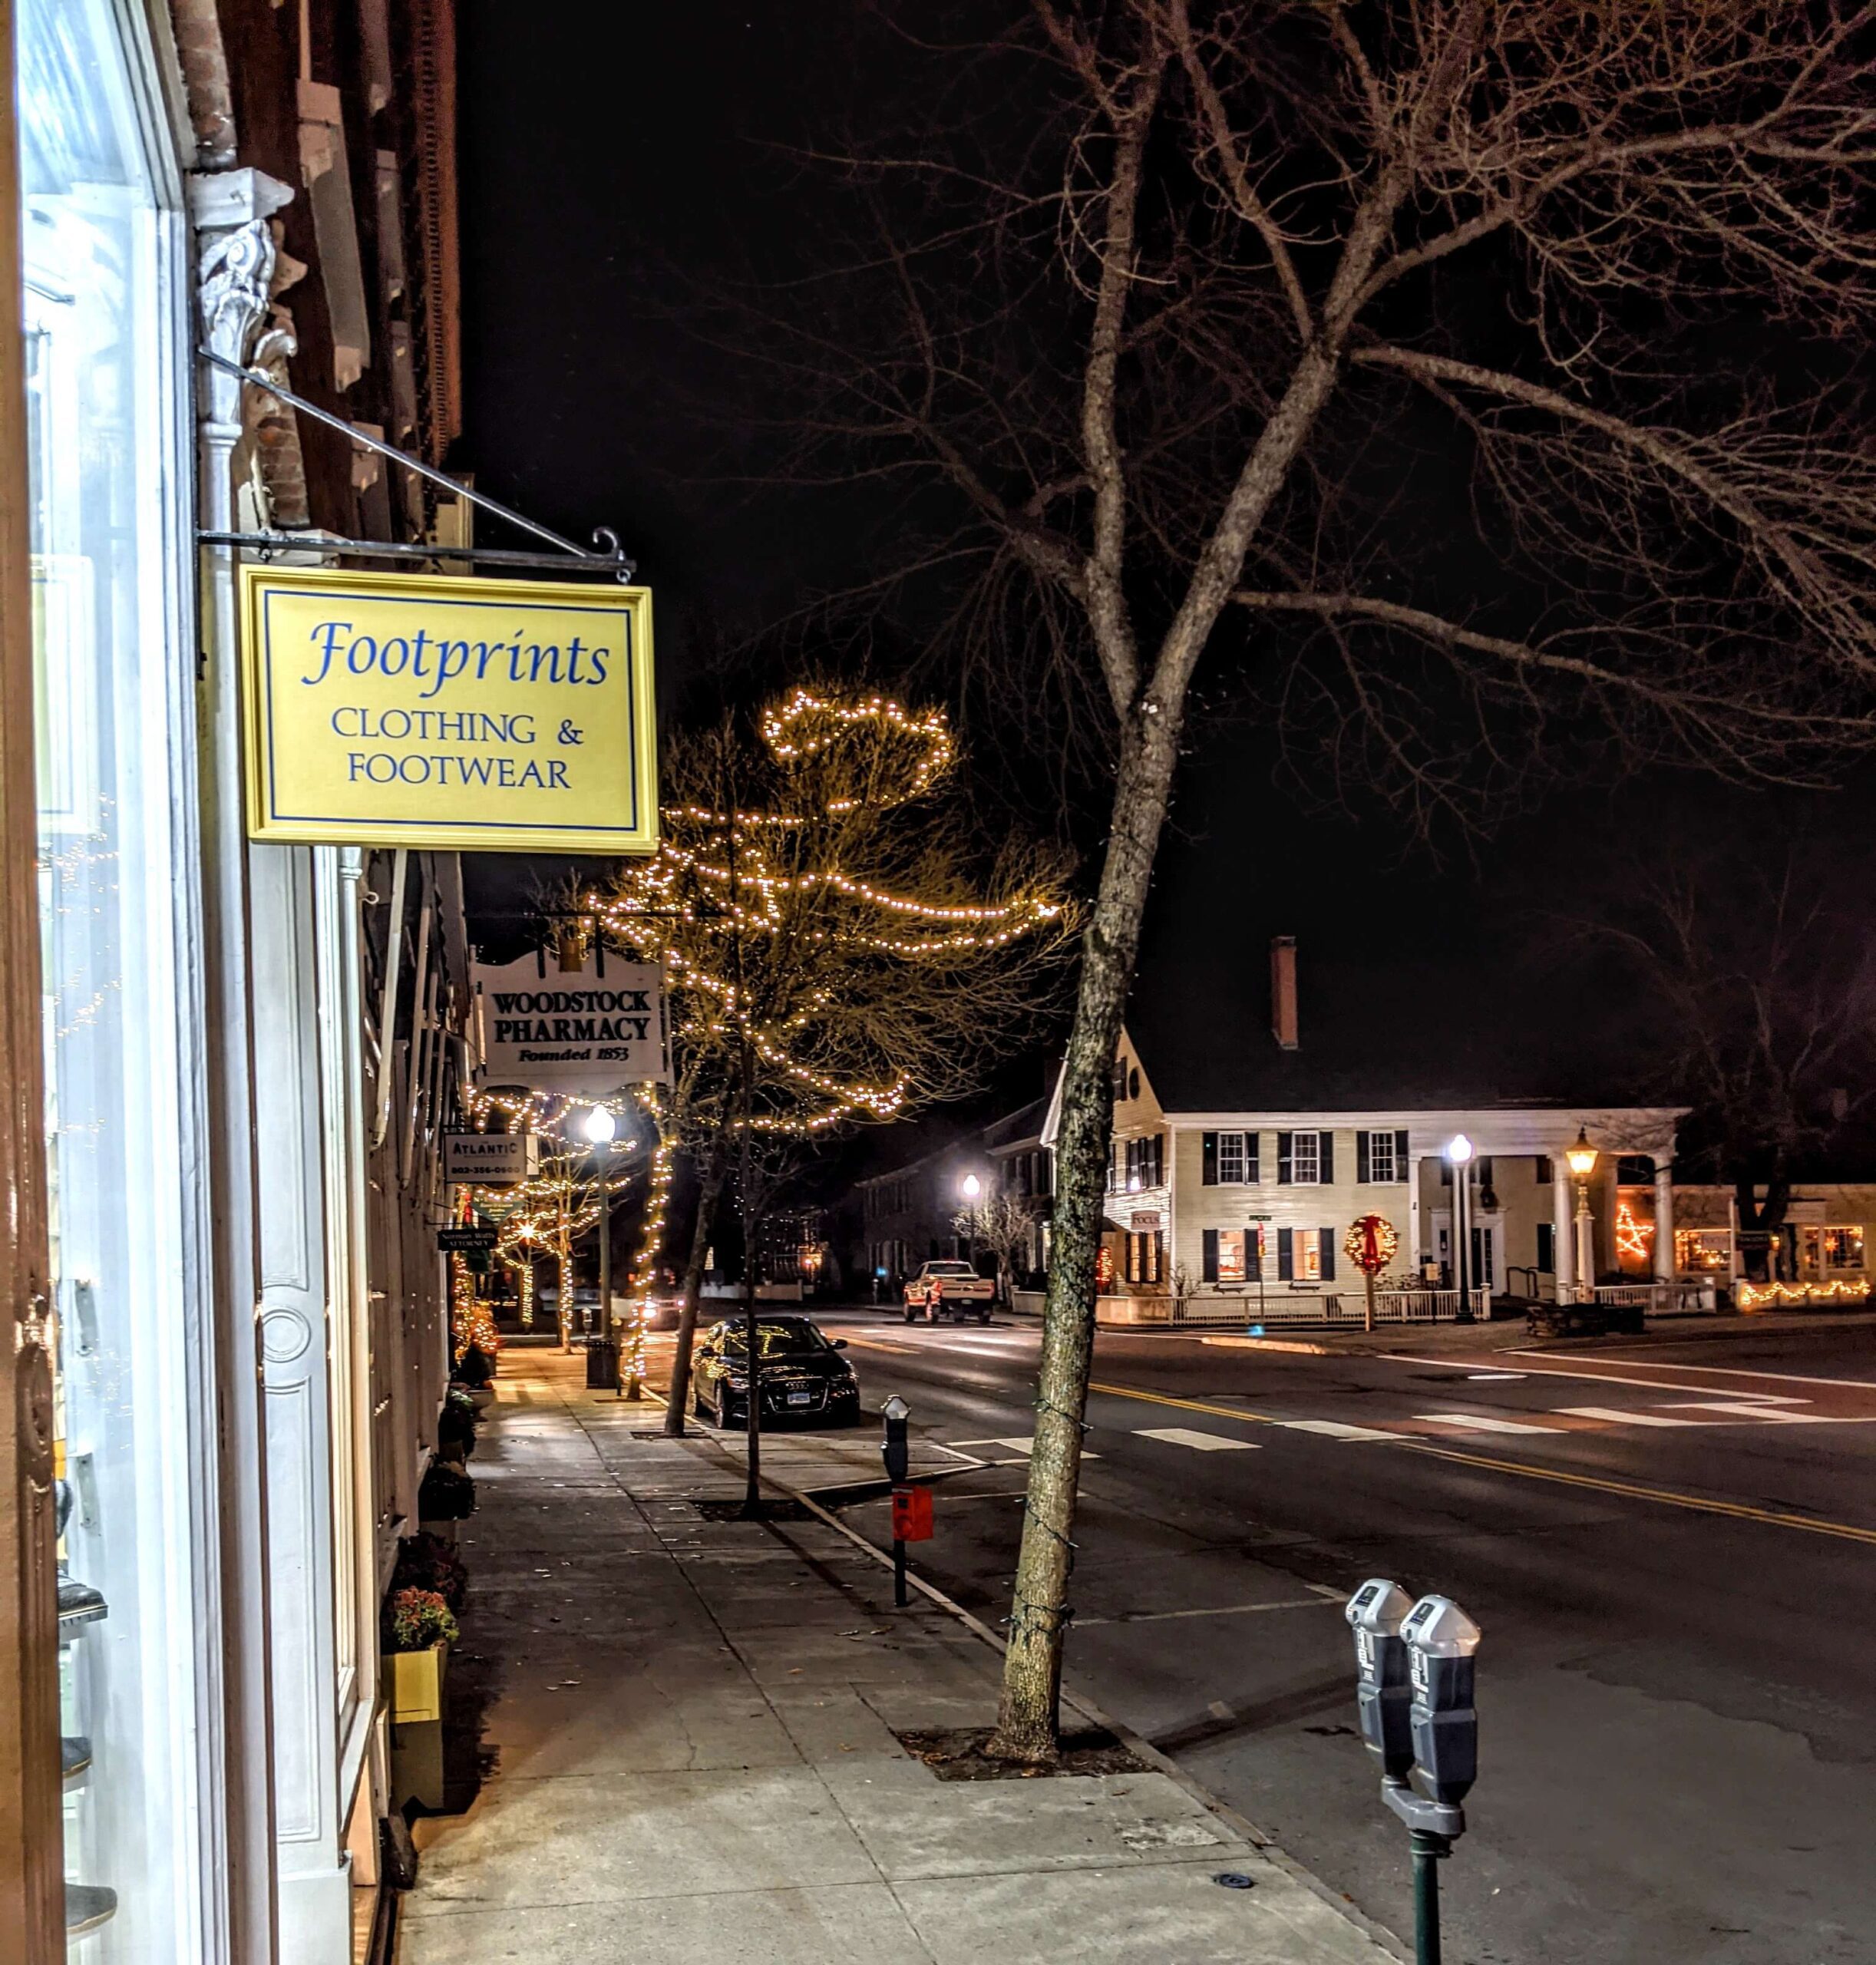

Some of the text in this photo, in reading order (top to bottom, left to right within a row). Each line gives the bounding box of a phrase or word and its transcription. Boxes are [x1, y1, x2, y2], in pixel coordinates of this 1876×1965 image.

[301, 623, 609, 698] Footprints
[332, 707, 585, 745] CLOTHING &
[348, 752, 571, 789] FOOTWEAR
[492, 990, 651, 1014] WOODSTOCK
[494, 1017, 651, 1042] PHARMACY
[519, 1047, 629, 1062] Founded 1853
[453, 1142, 518, 1154] ATLANTIC
